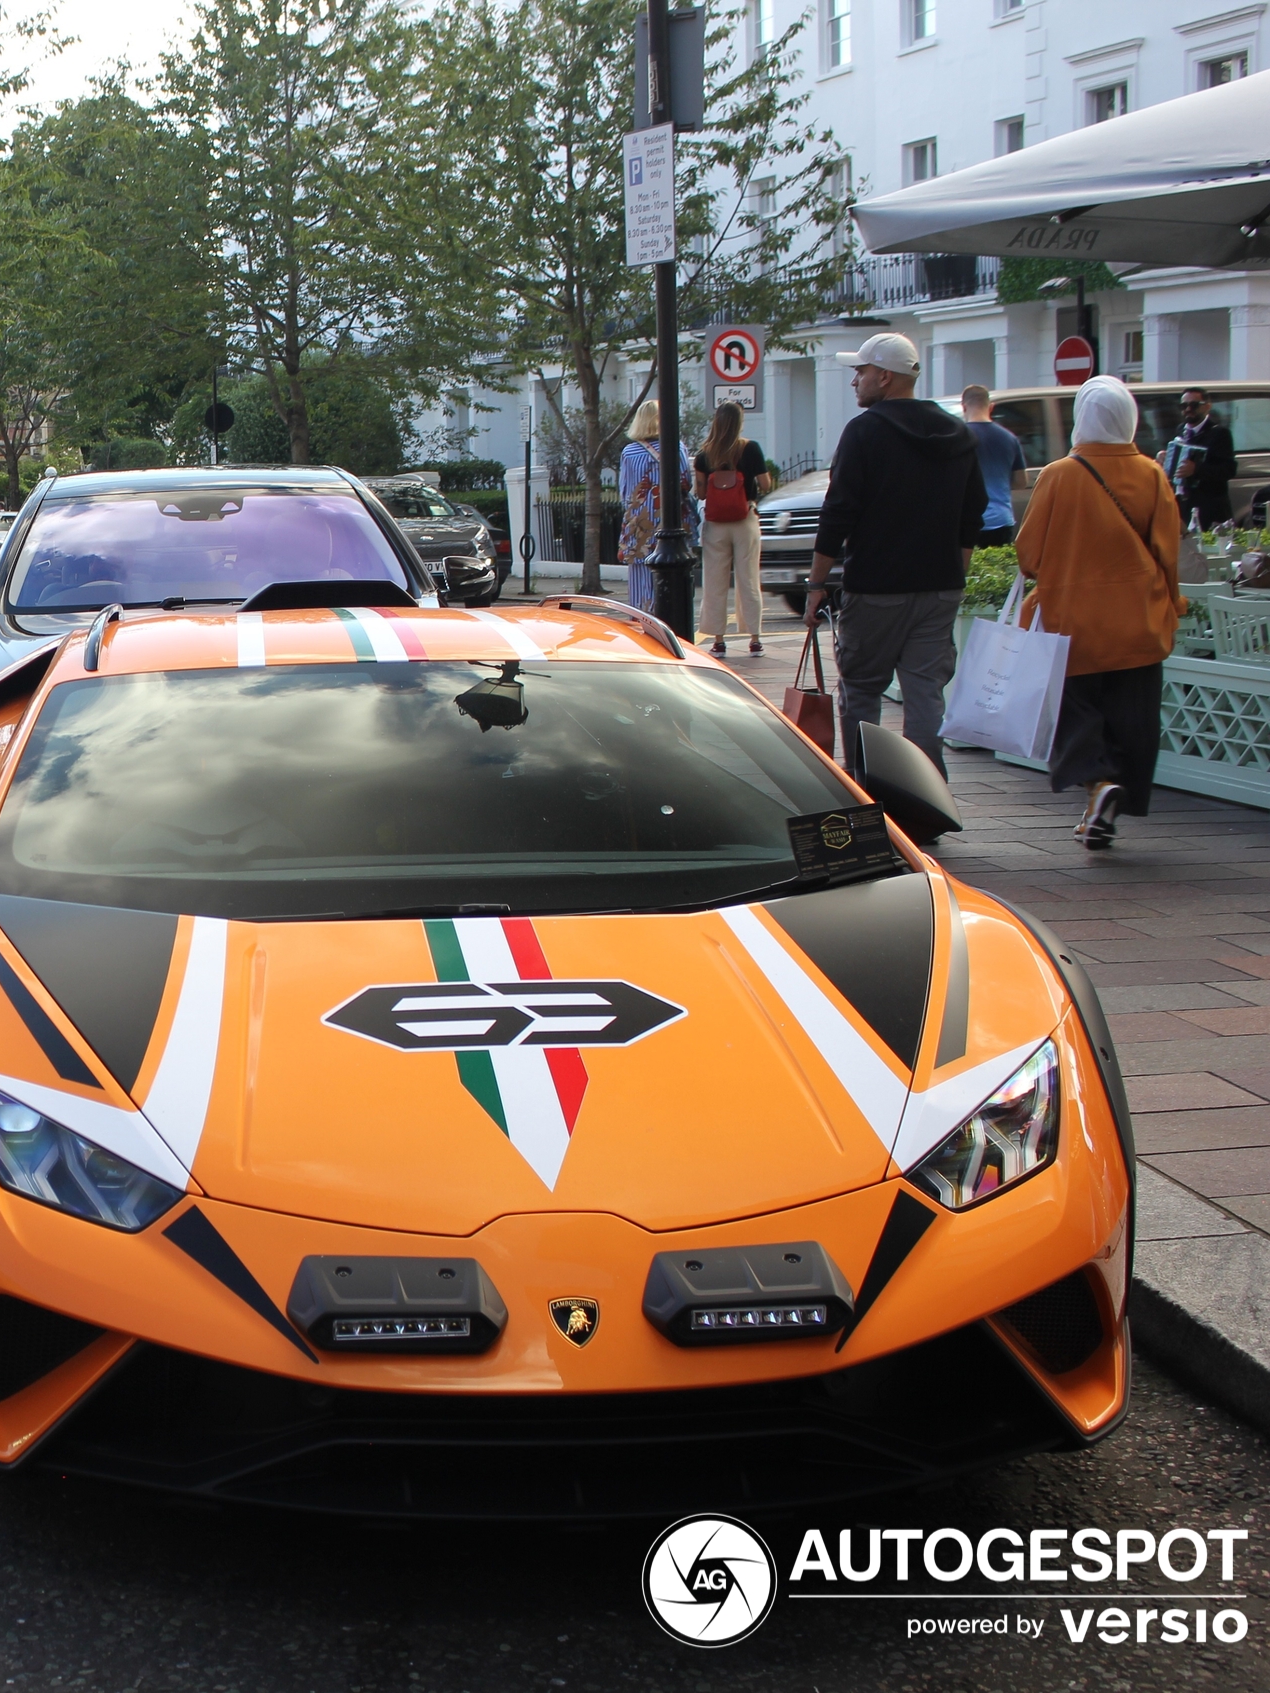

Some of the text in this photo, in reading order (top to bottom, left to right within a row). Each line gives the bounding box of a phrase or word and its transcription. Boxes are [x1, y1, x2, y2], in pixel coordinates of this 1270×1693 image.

[644, 132, 667, 146] Resident
[646, 145, 664, 157] permit
[646, 158, 665, 168] holders
[650, 169, 662, 179] only
[638, 214, 661, 225] Saturday
[641, 238, 659, 249] Sunday
[729, 388, 741, 396] For
[823, 829, 850, 838] MAYFAIR
[552, 1300, 595, 1309] LAMBORGHINI
